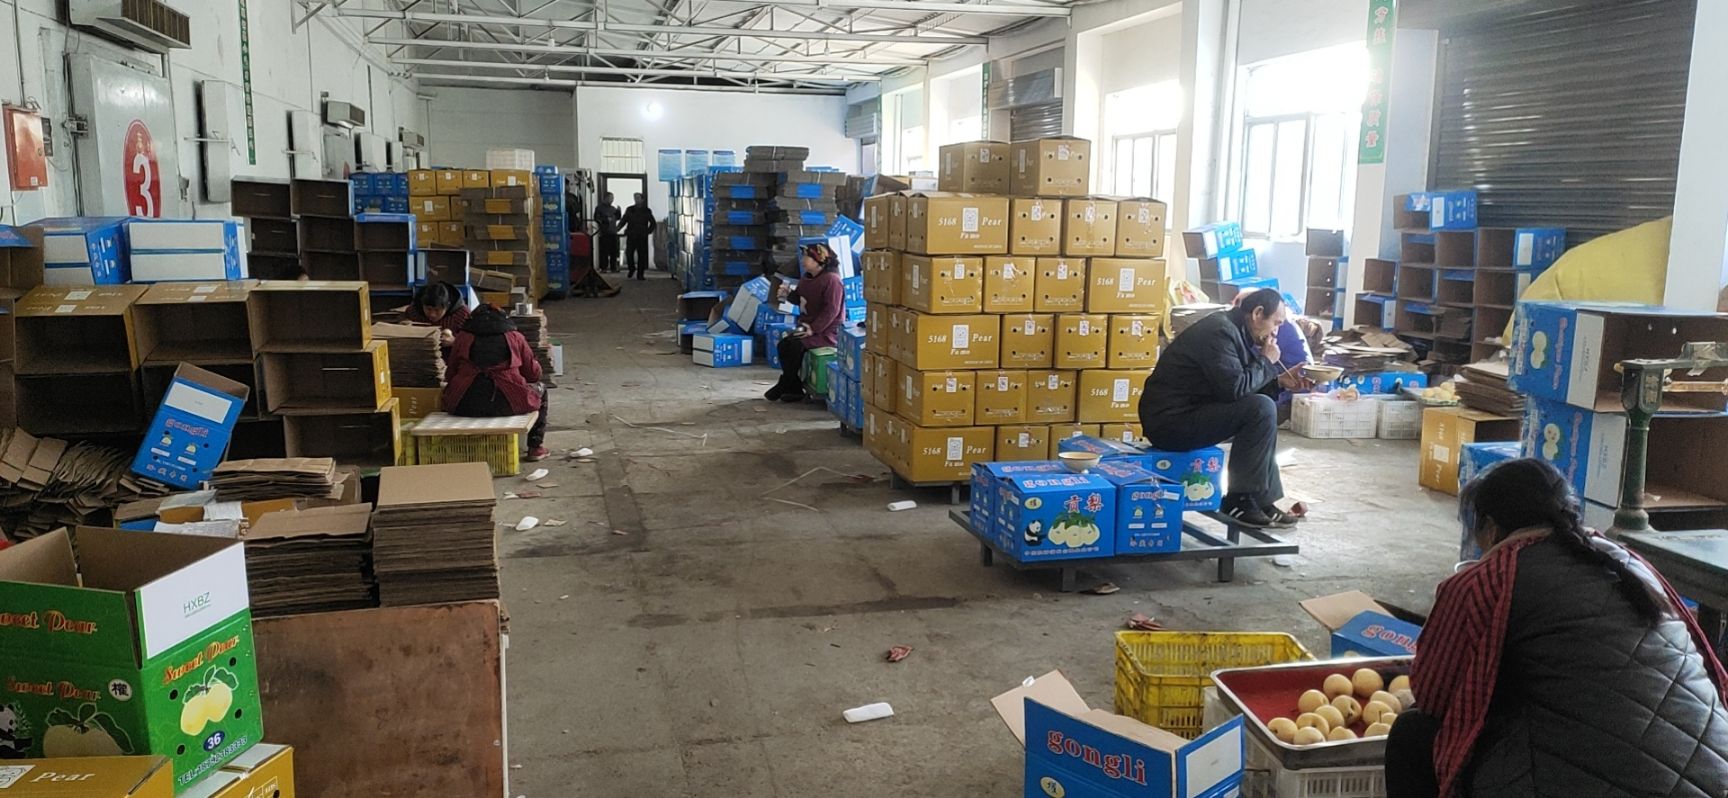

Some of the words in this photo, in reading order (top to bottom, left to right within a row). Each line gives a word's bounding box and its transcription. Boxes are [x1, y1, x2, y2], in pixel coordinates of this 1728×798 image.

[133, 153, 154, 217] 3
[938, 216, 957, 226] 5168
[982, 216, 1002, 226] Pear
[1096, 276, 1115, 286] 5168
[1136, 277, 1156, 286] Pear
[928, 334, 947, 343] 5168
[972, 333, 993, 342] Pear
[1090, 387, 1108, 397] 5168
[1131, 387, 1143, 396] Pe
[165, 418, 208, 438] gongli
[922, 447, 941, 456] 5168
[966, 445, 986, 454] Pear
[1022, 476, 1091, 488] gongli
[183, 591, 211, 614] HXBZ
[0, 611, 40, 629] weet
[42, 609, 98, 634] Pear
[7, 675, 54, 695] Sweet
[206, 732, 222, 750] 36
[1047, 730, 1148, 786] gongli
[30, 771, 96, 783] Pear
